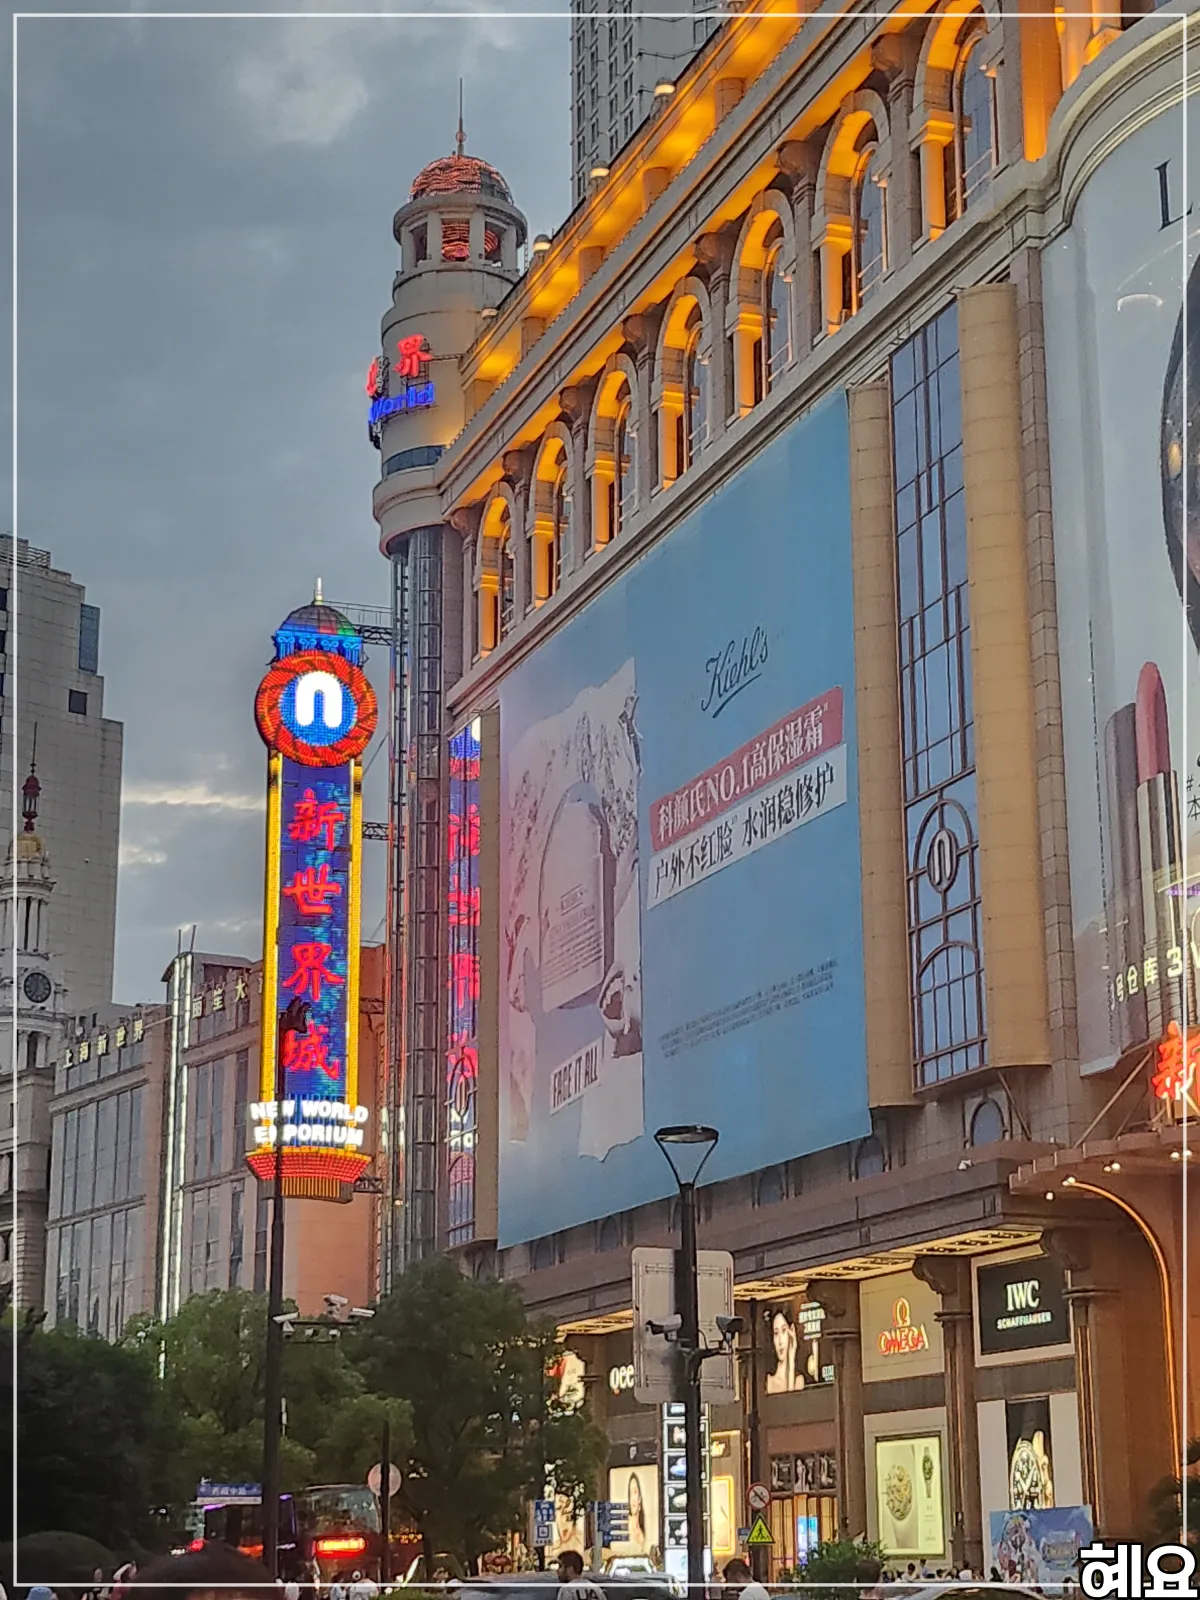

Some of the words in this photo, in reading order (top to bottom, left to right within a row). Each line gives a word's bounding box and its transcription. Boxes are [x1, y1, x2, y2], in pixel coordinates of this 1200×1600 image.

[701, 625, 768, 712] Kiehl's
[655, 821, 733, 899] 户外不红脸
[742, 761, 834, 847] 水润稳修护
[282, 787, 344, 1081] 新世界城
[63, 1019, 143, 1069] 上海新世界
[553, 1062, 573, 1109] FACE
[574, 1056, 582, 1094] IT
[584, 1045, 598, 1088] ALL
[250, 1100, 295, 1120] NEW
[301, 1100, 368, 1123] WORLD
[1007, 1280, 1039, 1311] IWC
[878, 1323, 929, 1356] OMEGA
